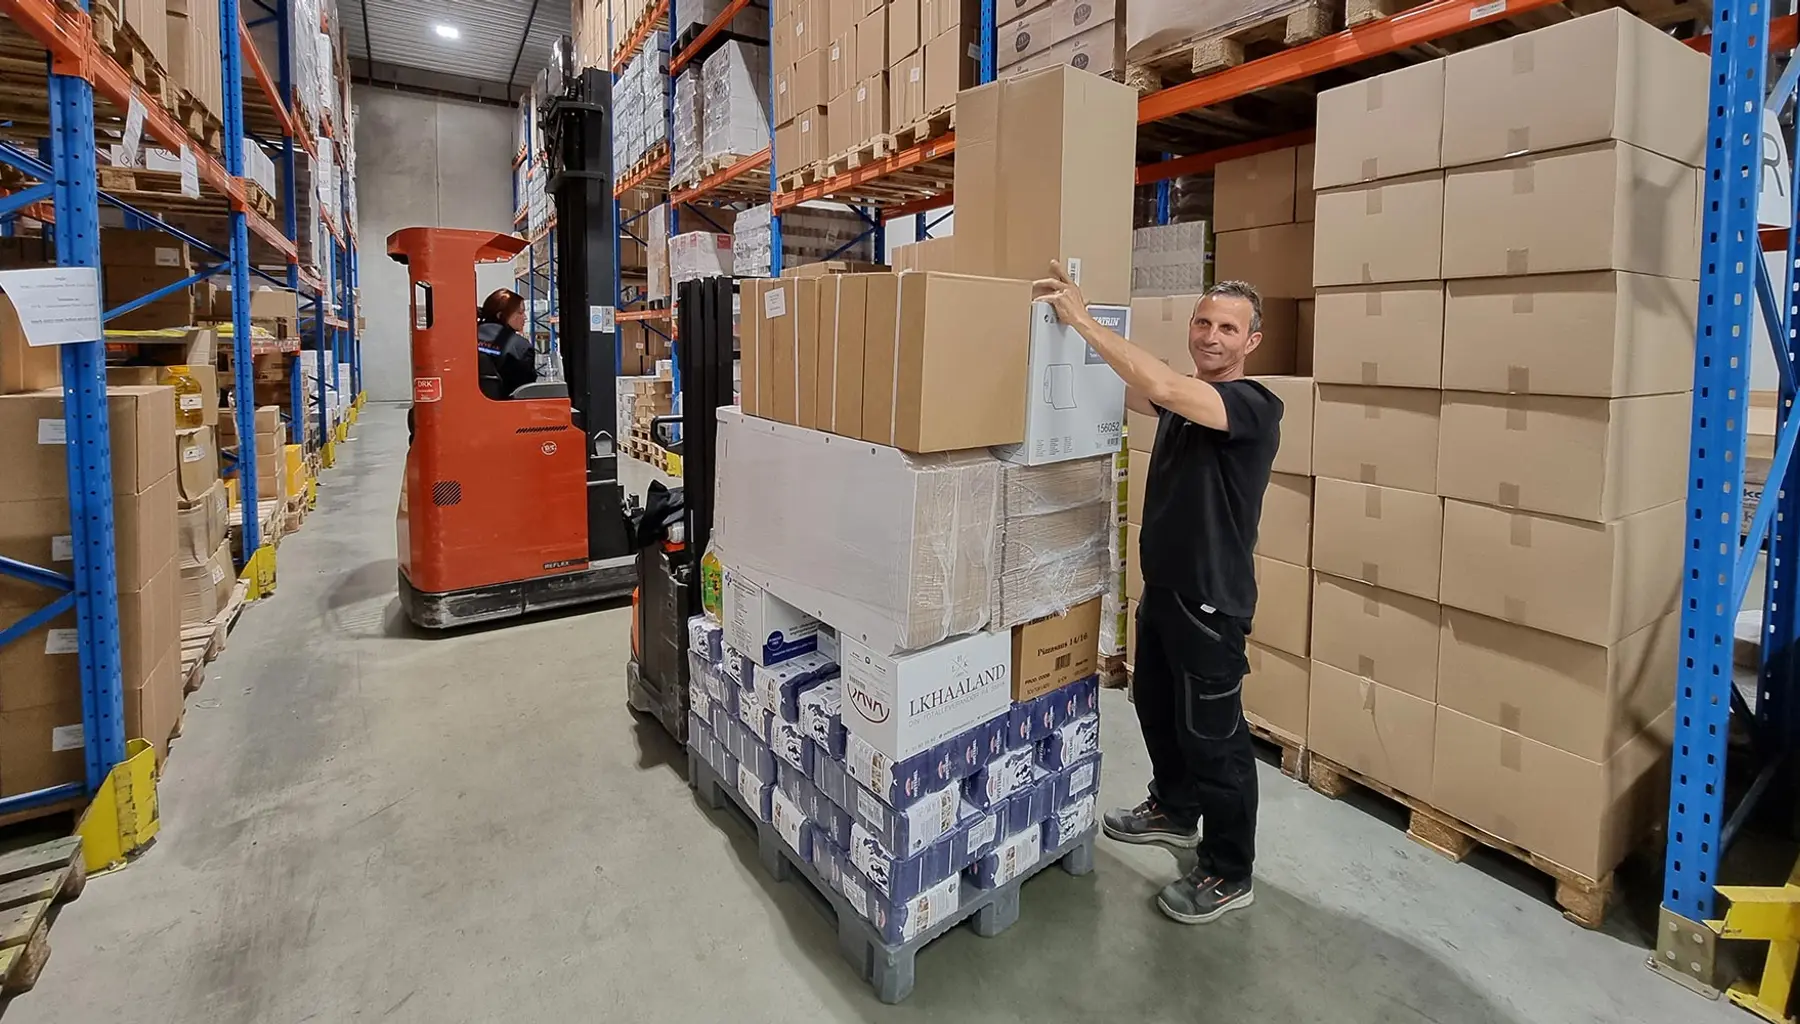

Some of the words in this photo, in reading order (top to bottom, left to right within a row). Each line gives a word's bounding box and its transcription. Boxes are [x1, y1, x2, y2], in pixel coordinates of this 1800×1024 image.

[417, 380, 433, 388] DRK
[1097, 421, 1120, 433] 156052
[544, 561, 569, 569] REFLEX
[1037, 640, 1068, 656] Pizzasaus
[1069, 633, 1088, 646] 14/16
[909, 663, 1006, 717] LKHAALAND
